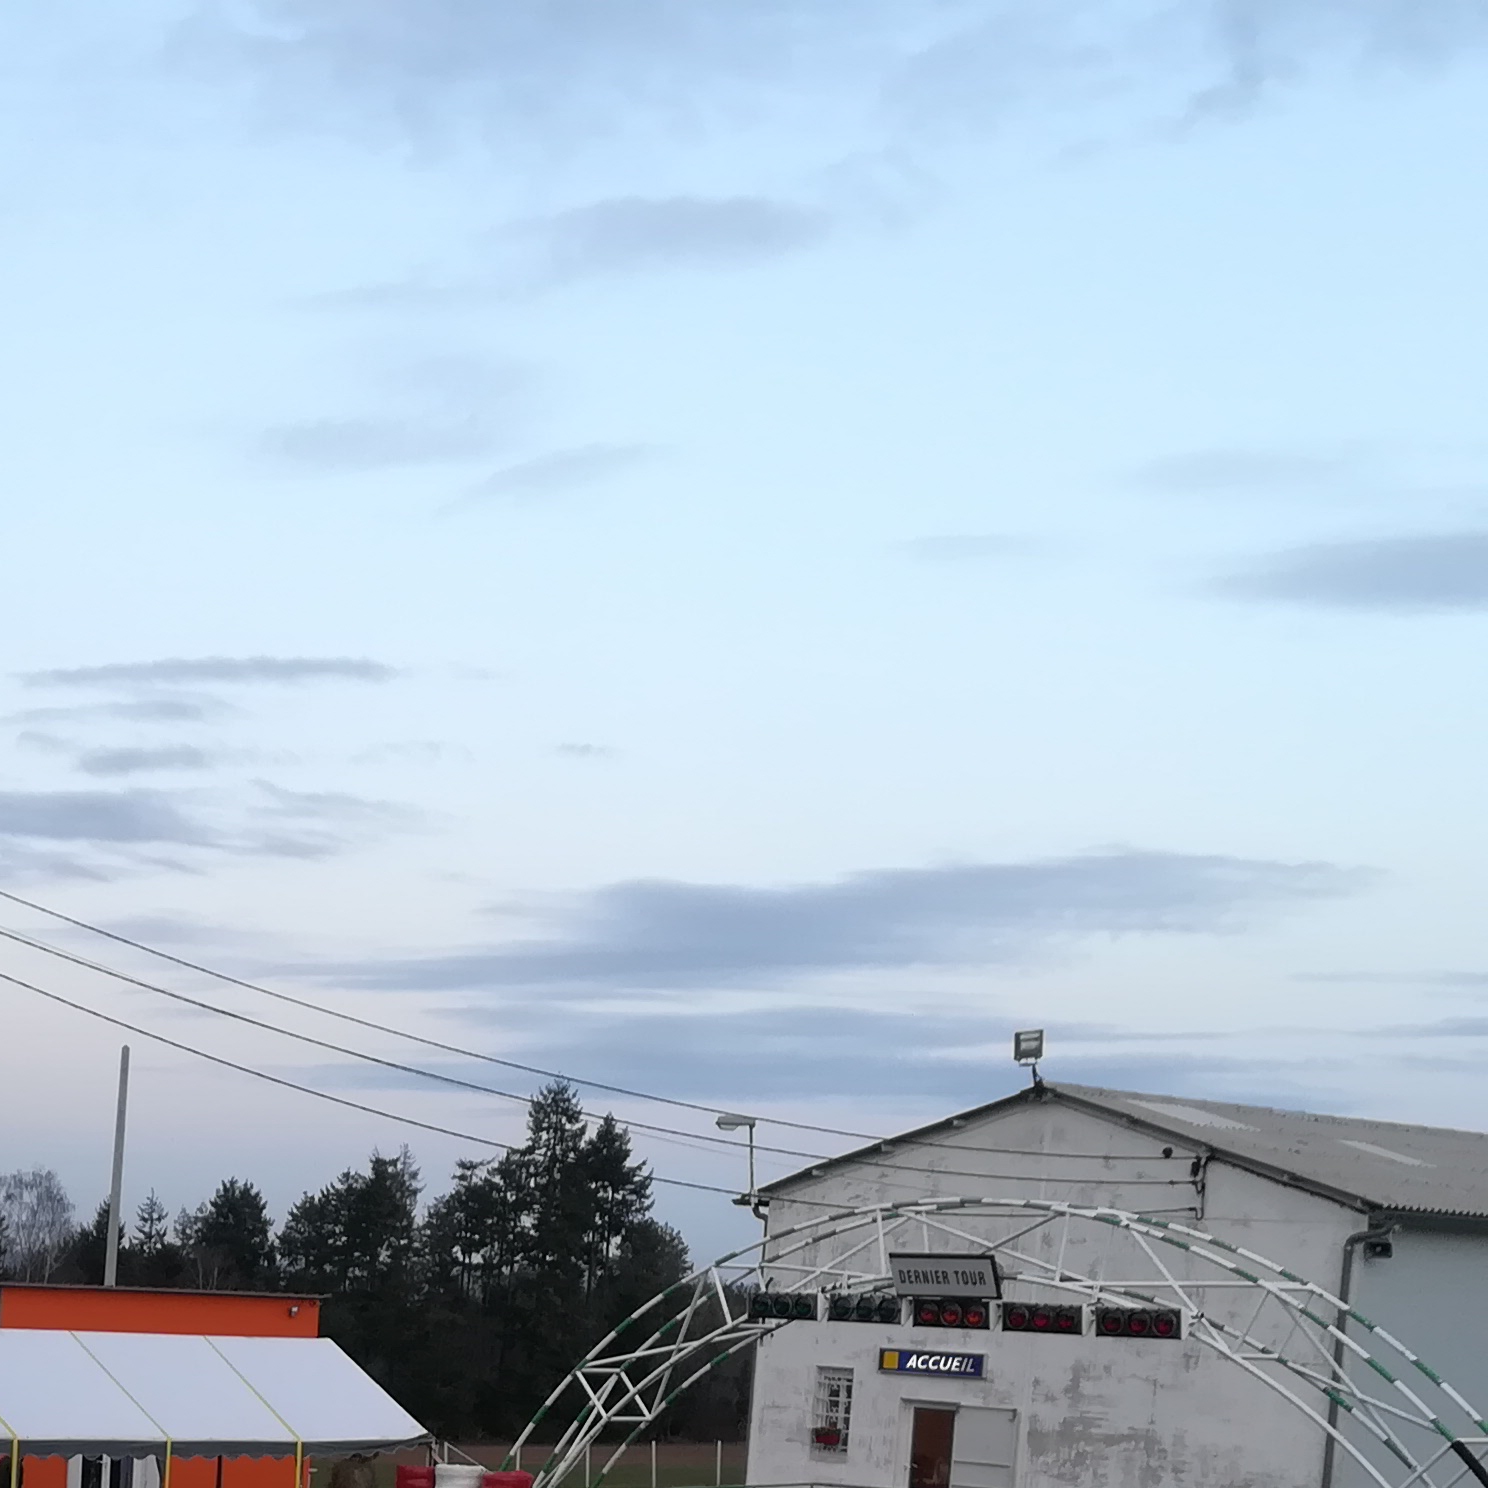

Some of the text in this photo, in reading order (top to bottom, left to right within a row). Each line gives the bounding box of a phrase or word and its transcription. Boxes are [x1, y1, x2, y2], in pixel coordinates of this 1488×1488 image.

[898, 1269, 987, 1286] DERNIER TOUR
[905, 1354, 975, 1373] ACCUEIL
